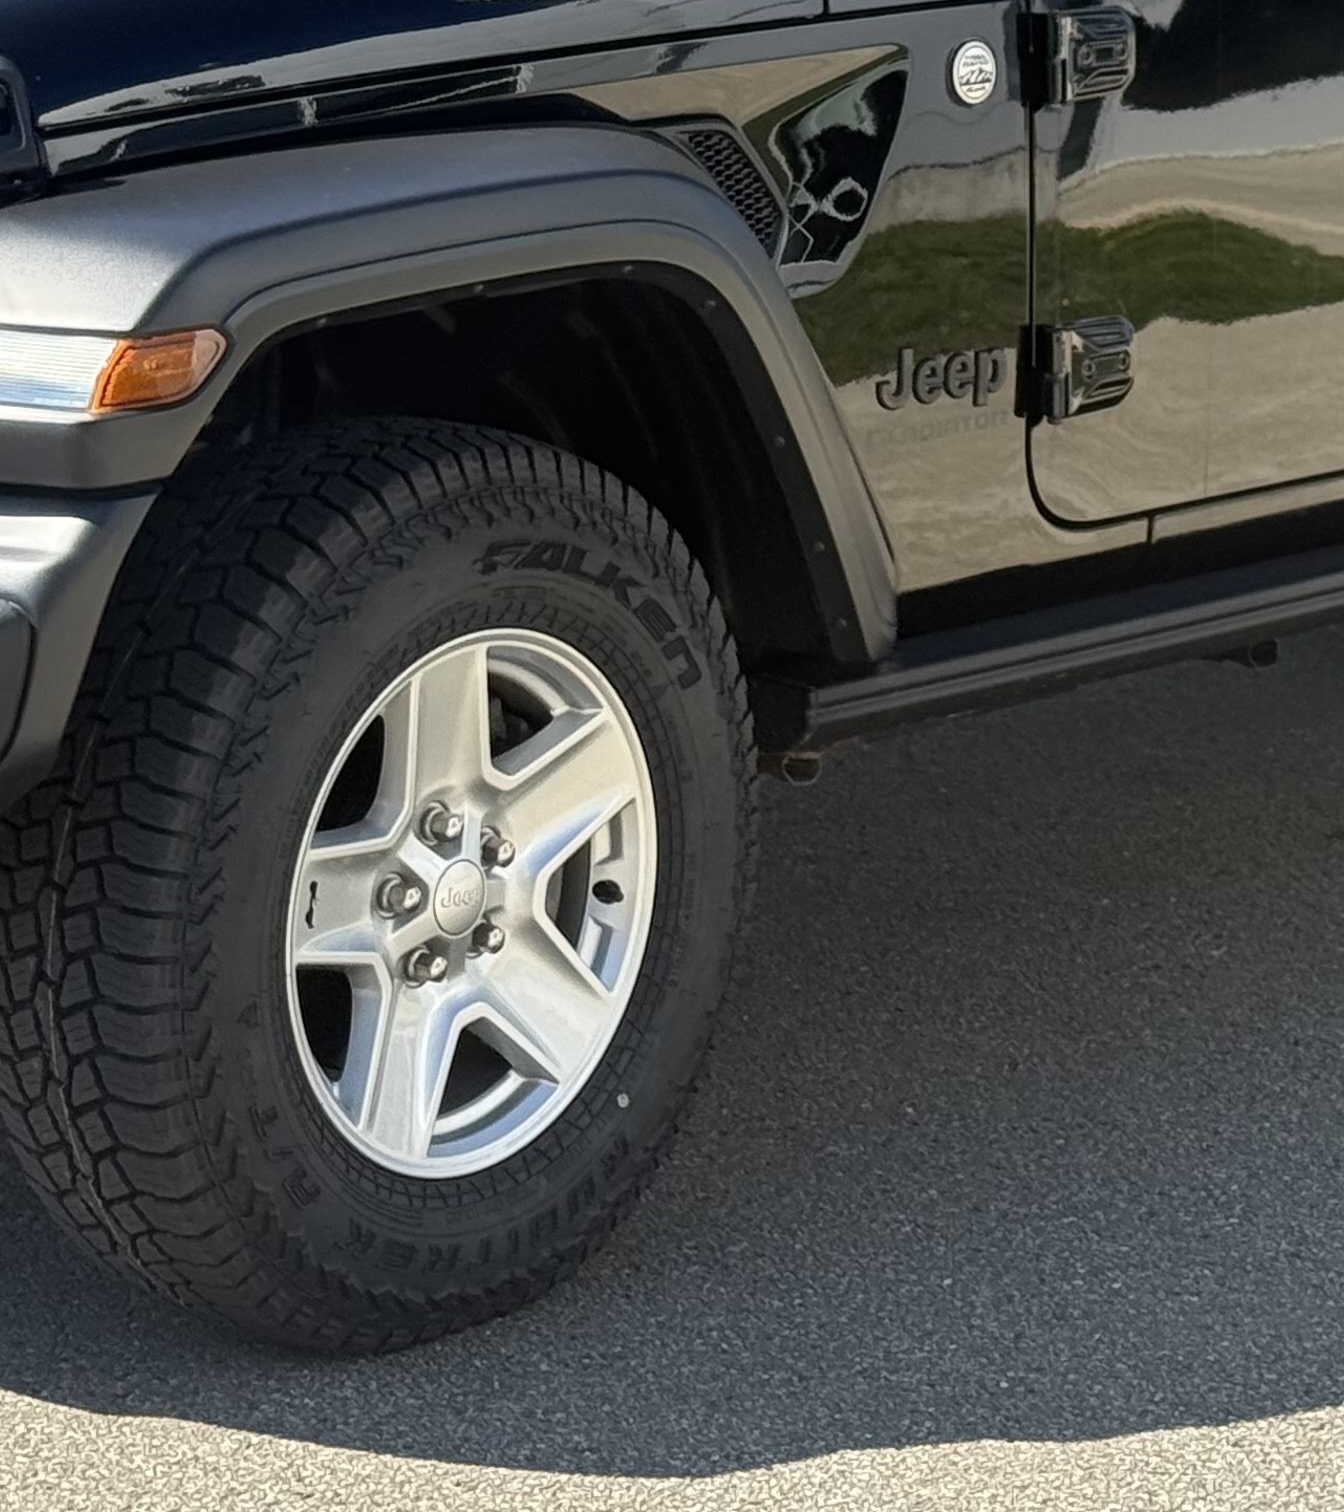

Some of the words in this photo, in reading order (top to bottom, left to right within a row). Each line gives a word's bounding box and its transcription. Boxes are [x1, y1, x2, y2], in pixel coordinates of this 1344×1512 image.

[875, 346, 1008, 411] Jeep
[472, 539, 703, 690] FALKEN
[440, 887, 481, 908] Jeep
